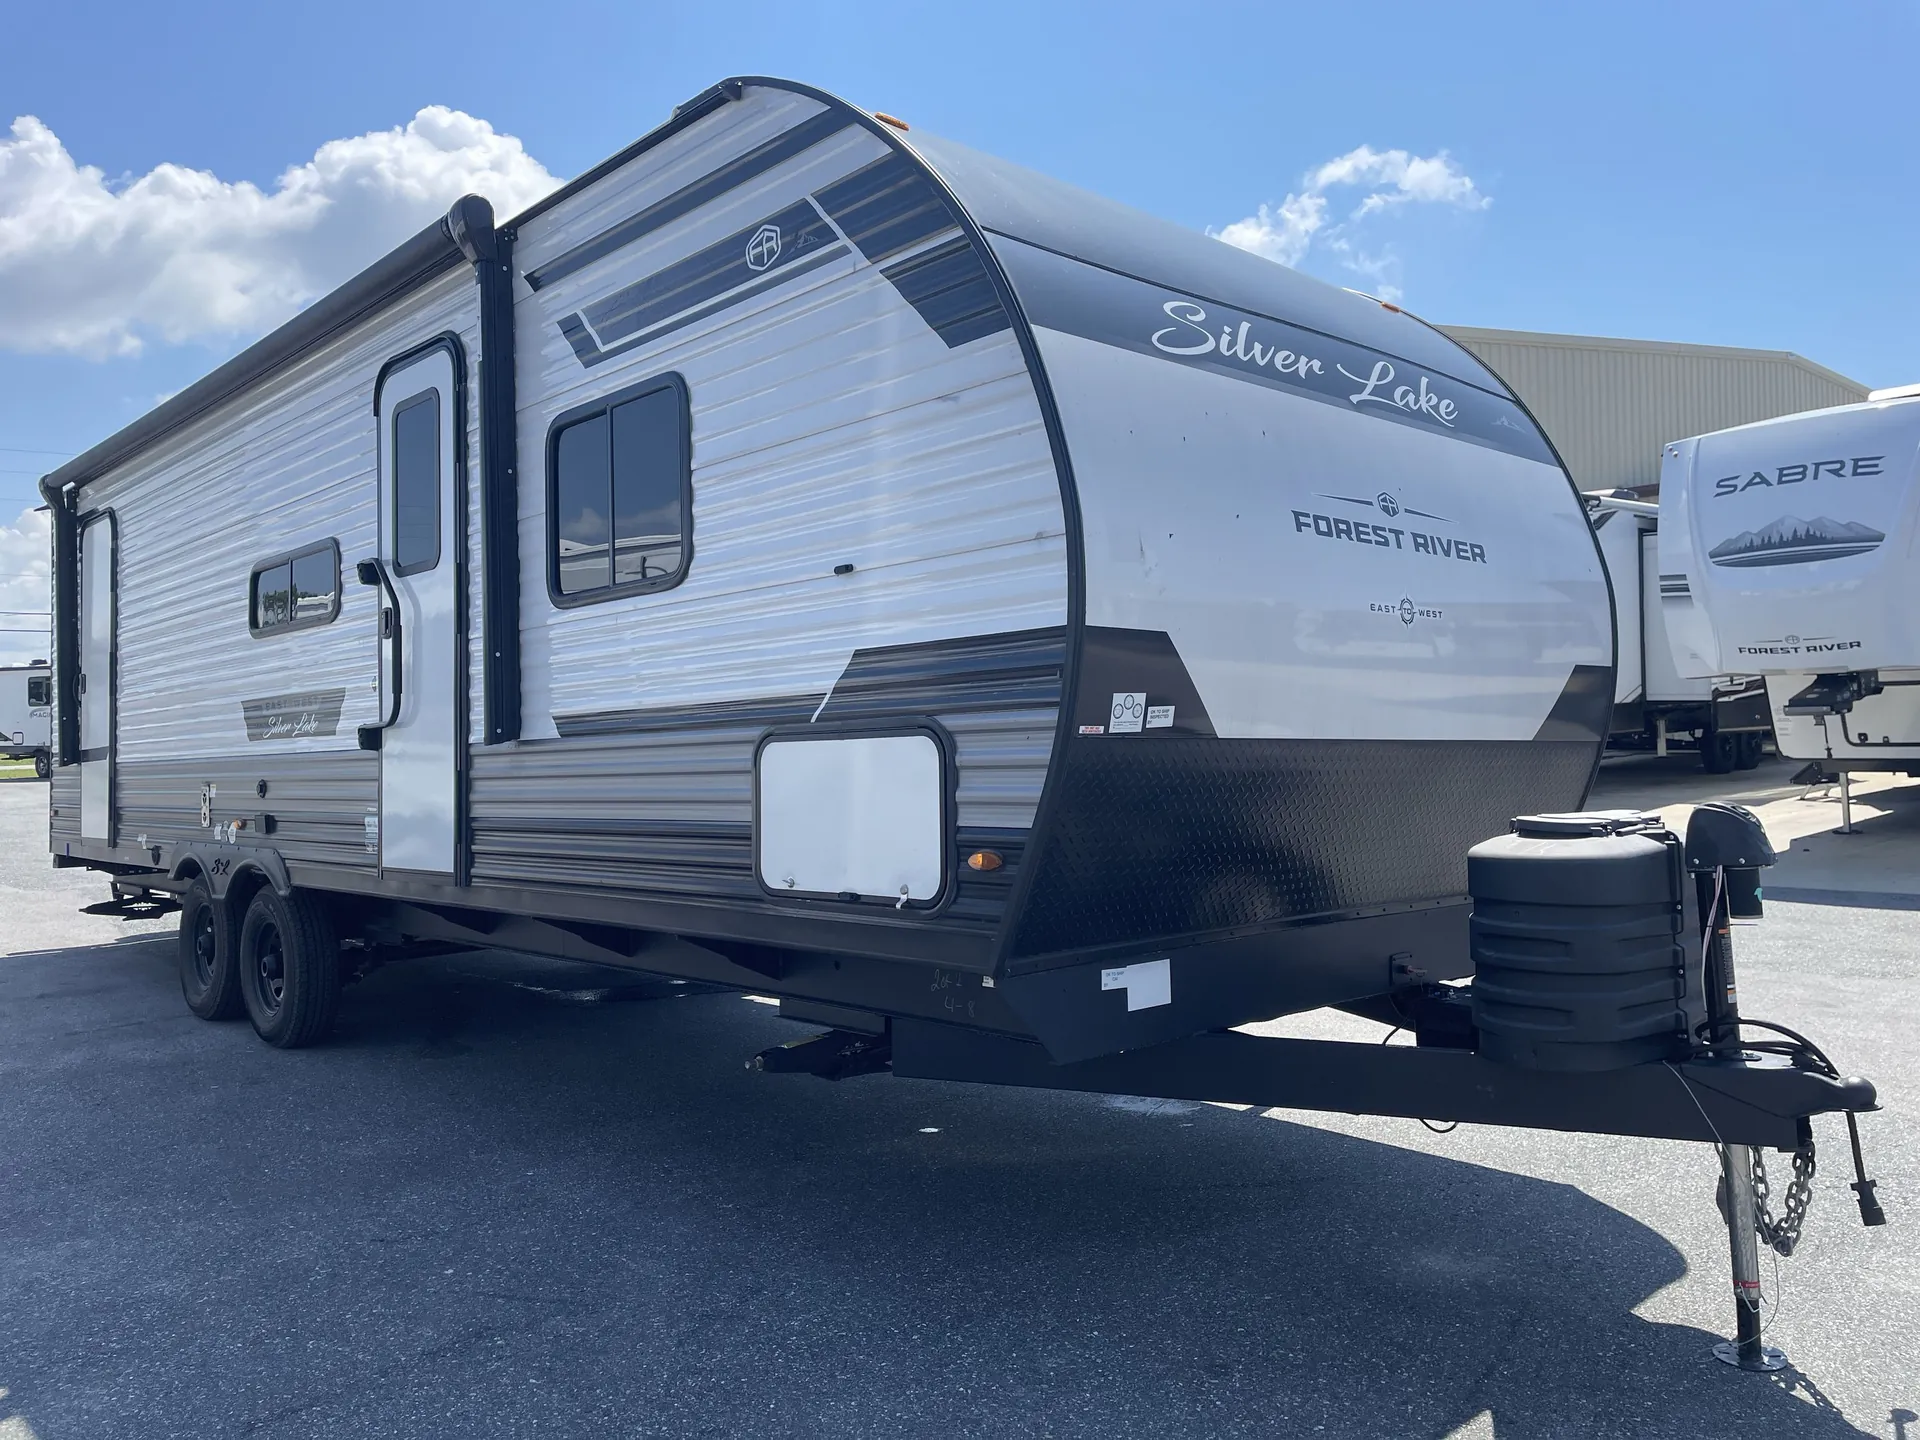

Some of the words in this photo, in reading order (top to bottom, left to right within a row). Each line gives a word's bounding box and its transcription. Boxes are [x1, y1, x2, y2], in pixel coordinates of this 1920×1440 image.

[1151, 301, 1324, 379] Silver
[1336, 361, 1458, 427] Lake
[1713, 455, 1886, 498] SABRE
[1291, 509, 1404, 550] FOREST
[1410, 531, 1487, 564] RIVER
[1370, 603, 1396, 614] EAST
[1403, 607, 1412, 615] TO
[1418, 609, 1443, 619] WEST
[1738, 646, 1800, 655] FOREST
[1805, 641, 1861, 653] RIVER
[263, 716, 291, 738] Silver
[292, 712, 318, 737] Lake
